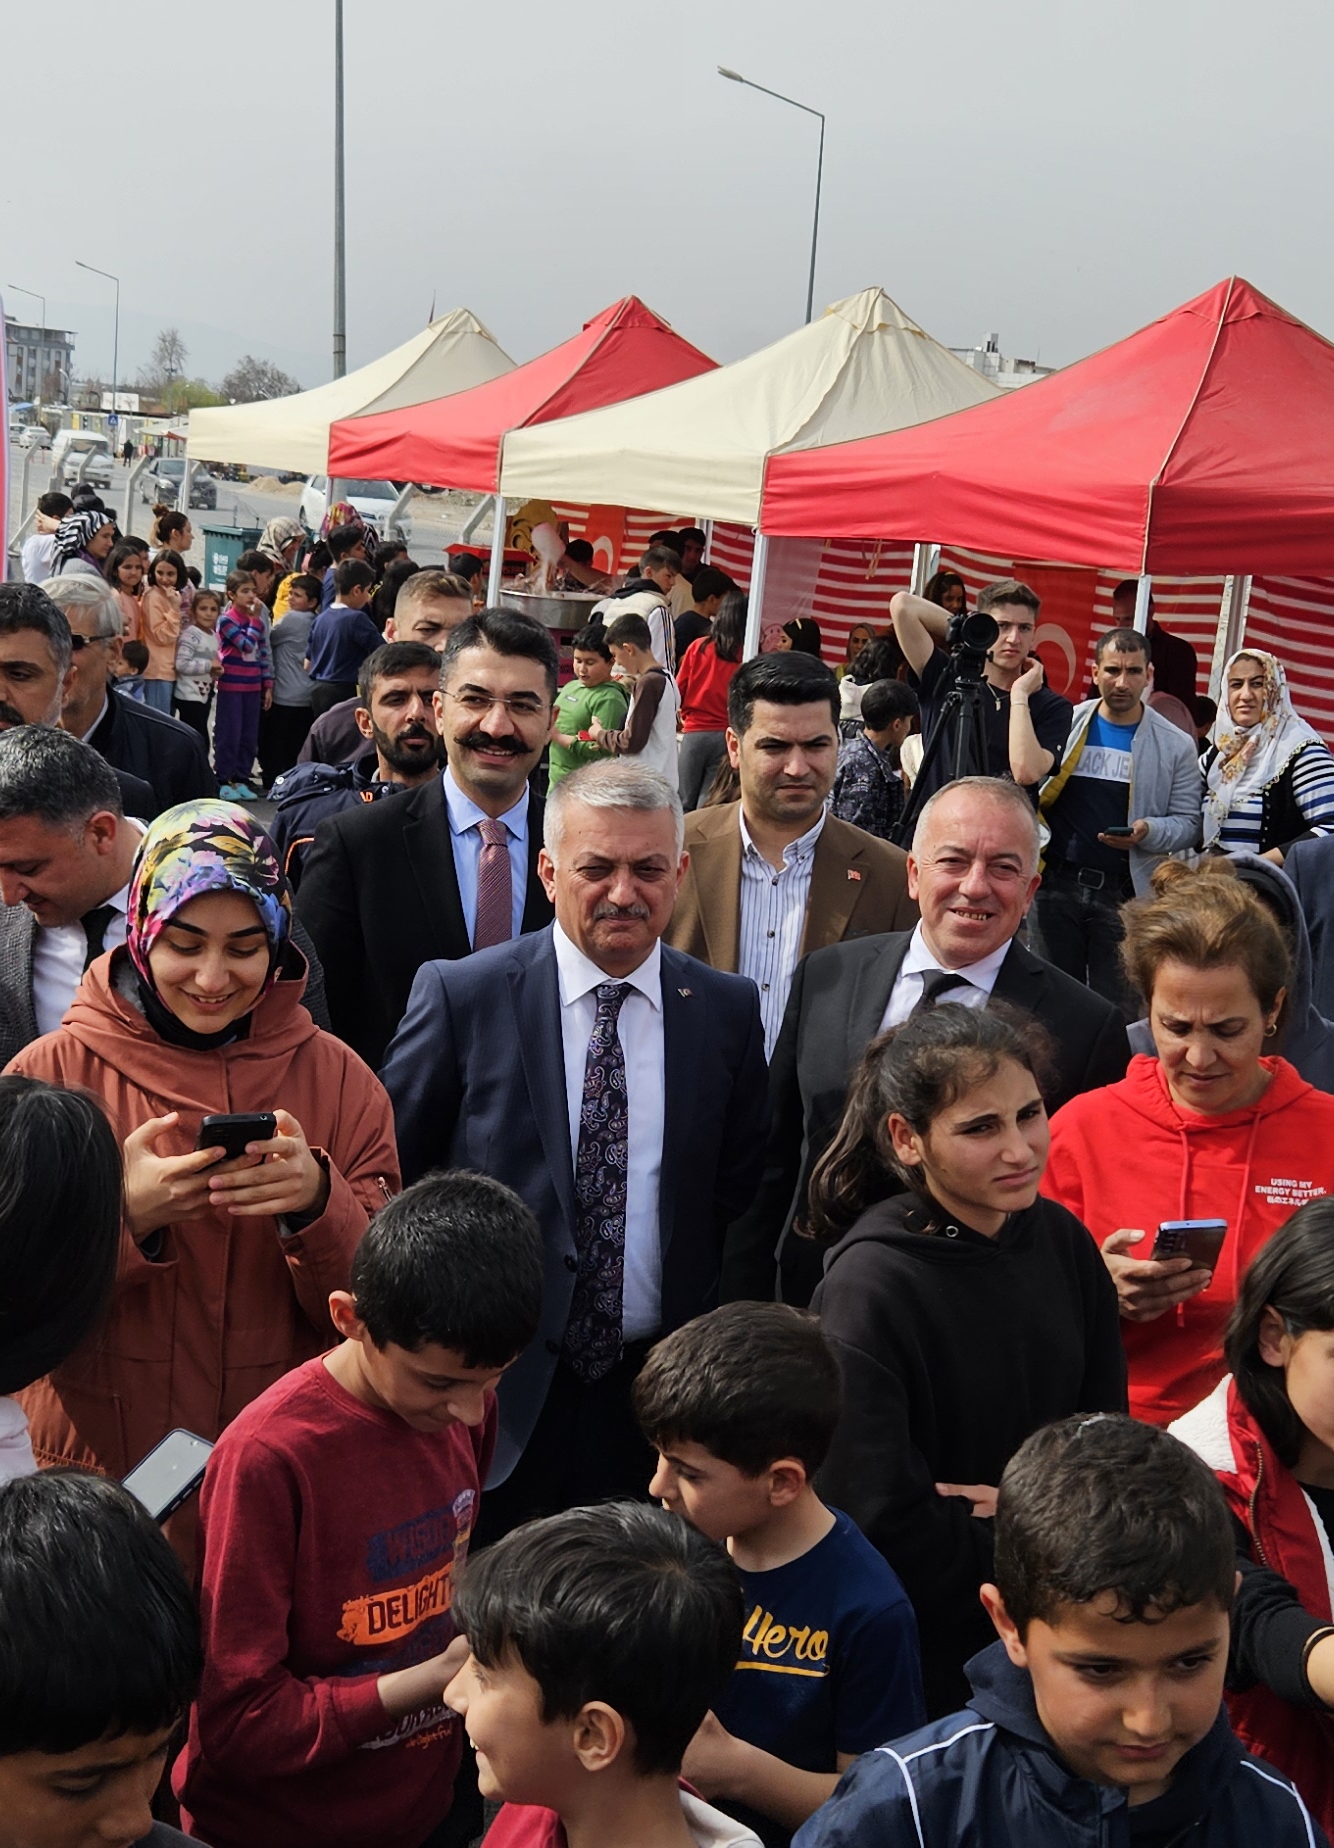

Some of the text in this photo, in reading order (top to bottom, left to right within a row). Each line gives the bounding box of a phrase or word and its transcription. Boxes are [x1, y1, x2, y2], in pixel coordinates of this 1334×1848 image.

[1076, 750, 1112, 776] LACK
[1255, 1185, 1291, 1196] ENERGY
[1270, 1178, 1312, 1189] USING MY
[742, 1604, 829, 1661] Hero
